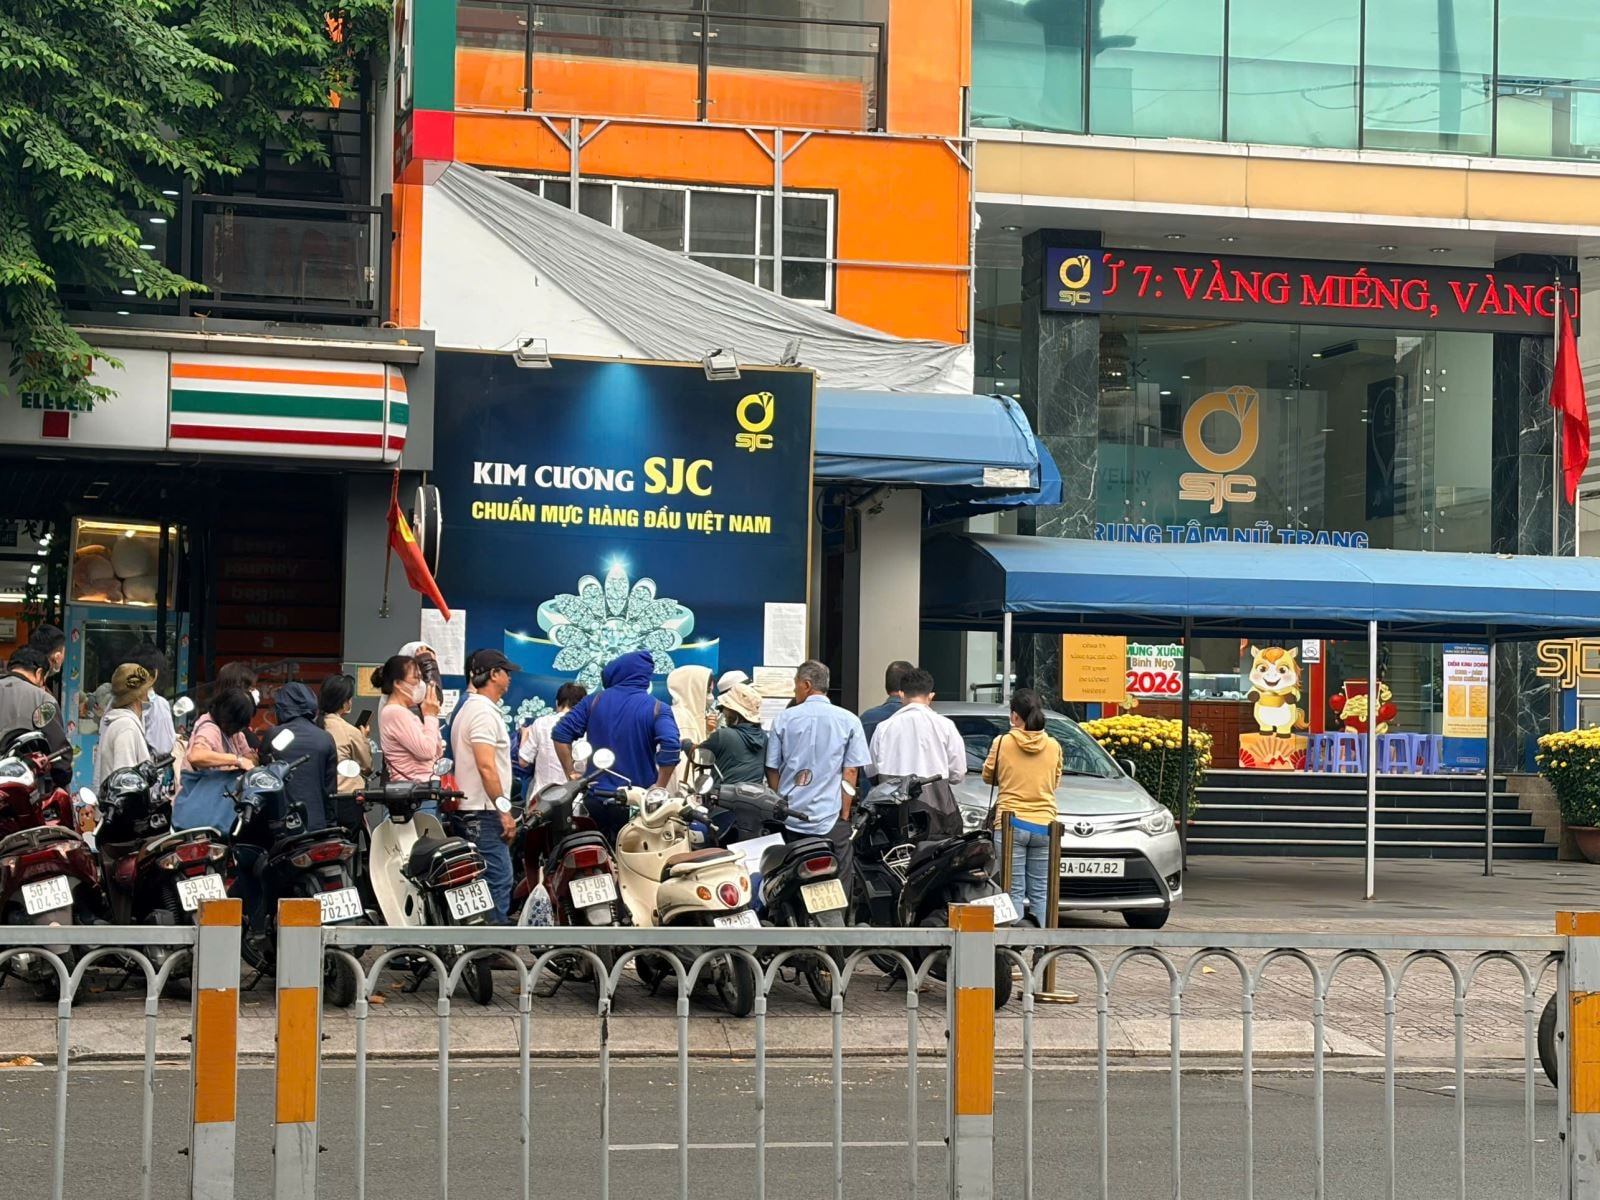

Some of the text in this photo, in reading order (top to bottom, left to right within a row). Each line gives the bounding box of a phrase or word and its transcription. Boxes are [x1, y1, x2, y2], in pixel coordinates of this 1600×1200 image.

[1132, 265, 1164, 298] 7:
[1172, 259, 1292, 305] VÀNG
[1299, 267, 1440, 318] MIẾNG,
[1447, 274, 1566, 318] VÀNG
[735, 432, 773, 452] SJC
[473, 456, 713, 497] KIM CƯƠNG SJC
[1178, 472, 1257, 514] SJC
[471, 496, 771, 534] CHUẨN MỰC HÀNG ĐẦU VIỆT NAM
[1167, 519, 1228, 544] TÂM
[1277, 529, 1369, 549] TRANG
[1126, 671, 1182, 693] 2026
[451, 884, 483, 903] 79-H3
[456, 896, 487, 916] 8145
